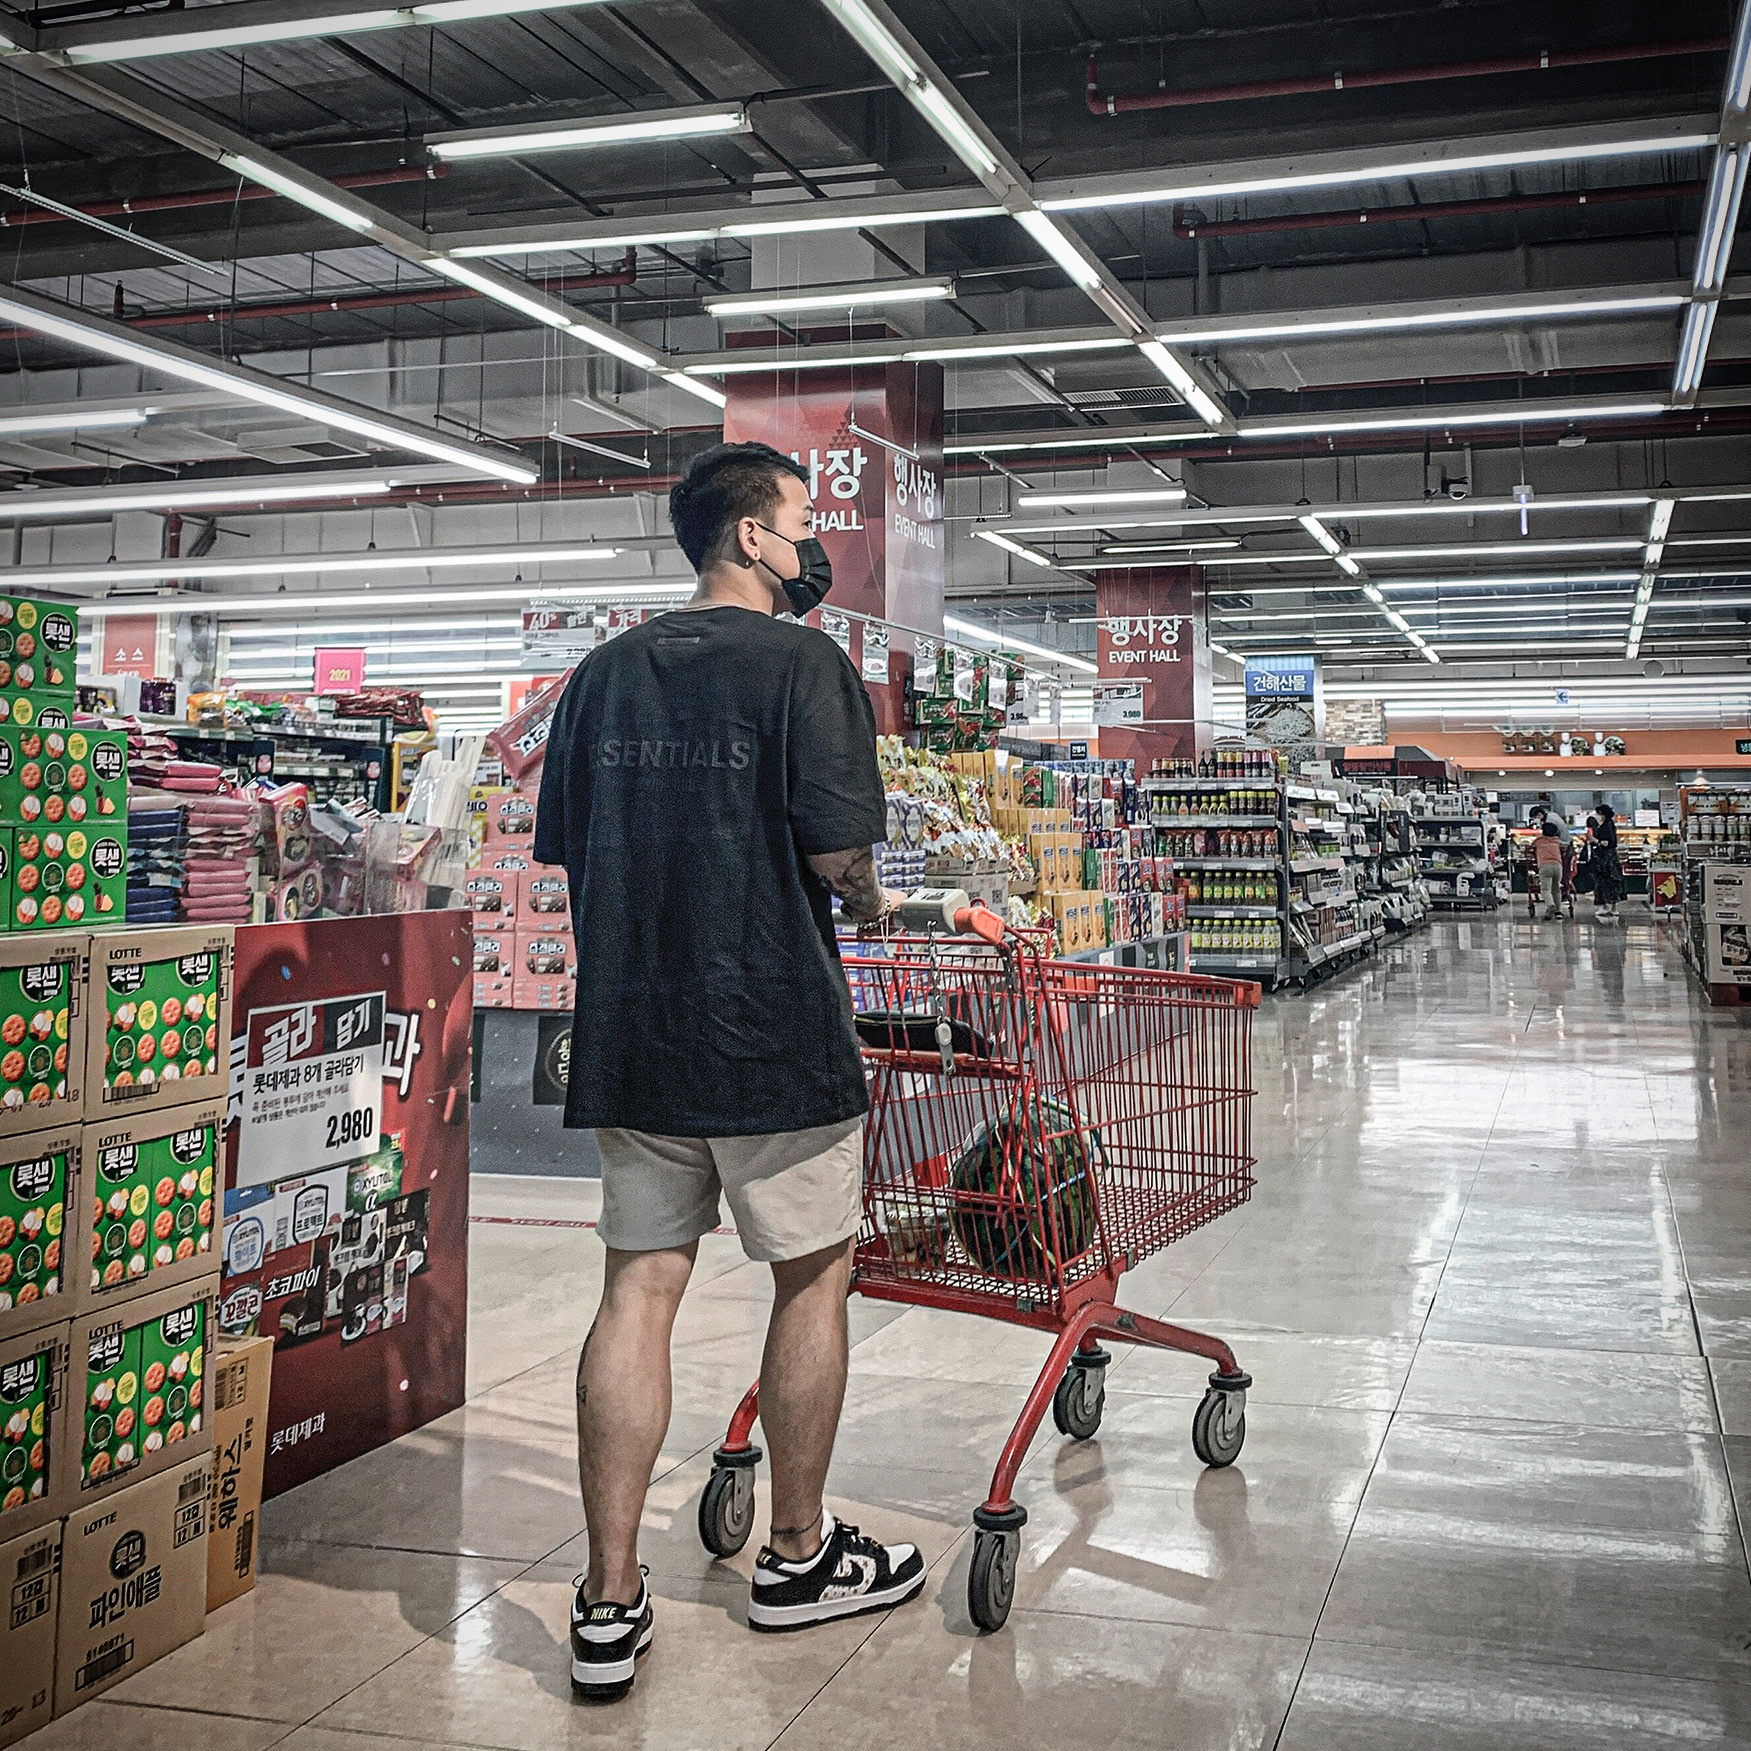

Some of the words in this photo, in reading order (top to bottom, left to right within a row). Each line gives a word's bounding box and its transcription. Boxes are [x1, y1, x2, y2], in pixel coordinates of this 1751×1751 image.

[894, 453, 936, 518] 행사장
[812, 509, 865, 532] HALL
[895, 513, 917, 541] EVENT
[918, 524, 936, 549] HALL
[44, 626, 71, 644] 롯샌
[1106, 615, 1183, 646] 행사장
[1109, 650, 1147, 664] EVENT
[1149, 649, 1181, 663] HALL
[329, 668, 351, 682] 2021
[1253, 675, 1307, 692] 건해산물
[96, 751, 120, 771] 롯샌
[95, 847, 120, 867] 롯샌
[109, 948, 142, 960] LOTTE
[182, 954, 208, 975] 롯샌
[26, 966, 57, 989] 롯샌
[262, 1004, 317, 1067] 골라
[337, 998, 371, 1050] 담기
[253, 1068, 301, 1095] 롯데제과
[304, 1062, 322, 1083] 8개
[325, 1053, 364, 1081] 골라담기
[98, 1131, 132, 1147] LOTTE
[325, 1107, 373, 1150] 2,980
[175, 1130, 202, 1153] 롯샌
[104, 1146, 134, 1170] 롯샌
[17, 1161, 50, 1188] 롯샌
[264, 1264, 321, 1302] 초코파이
[89, 1320, 124, 1339] LOTTE
[165, 1307, 193, 1337] 롯샌
[2, 1359, 35, 1392] 롯샌
[270, 1411, 326, 1456] 롯데제과
[218, 1433, 243, 1531] 웨하스
[83, 1511, 118, 1537] LOTTE
[88, 1563, 162, 1629] 파인애플
[590, 1607, 617, 1620] NIKE
